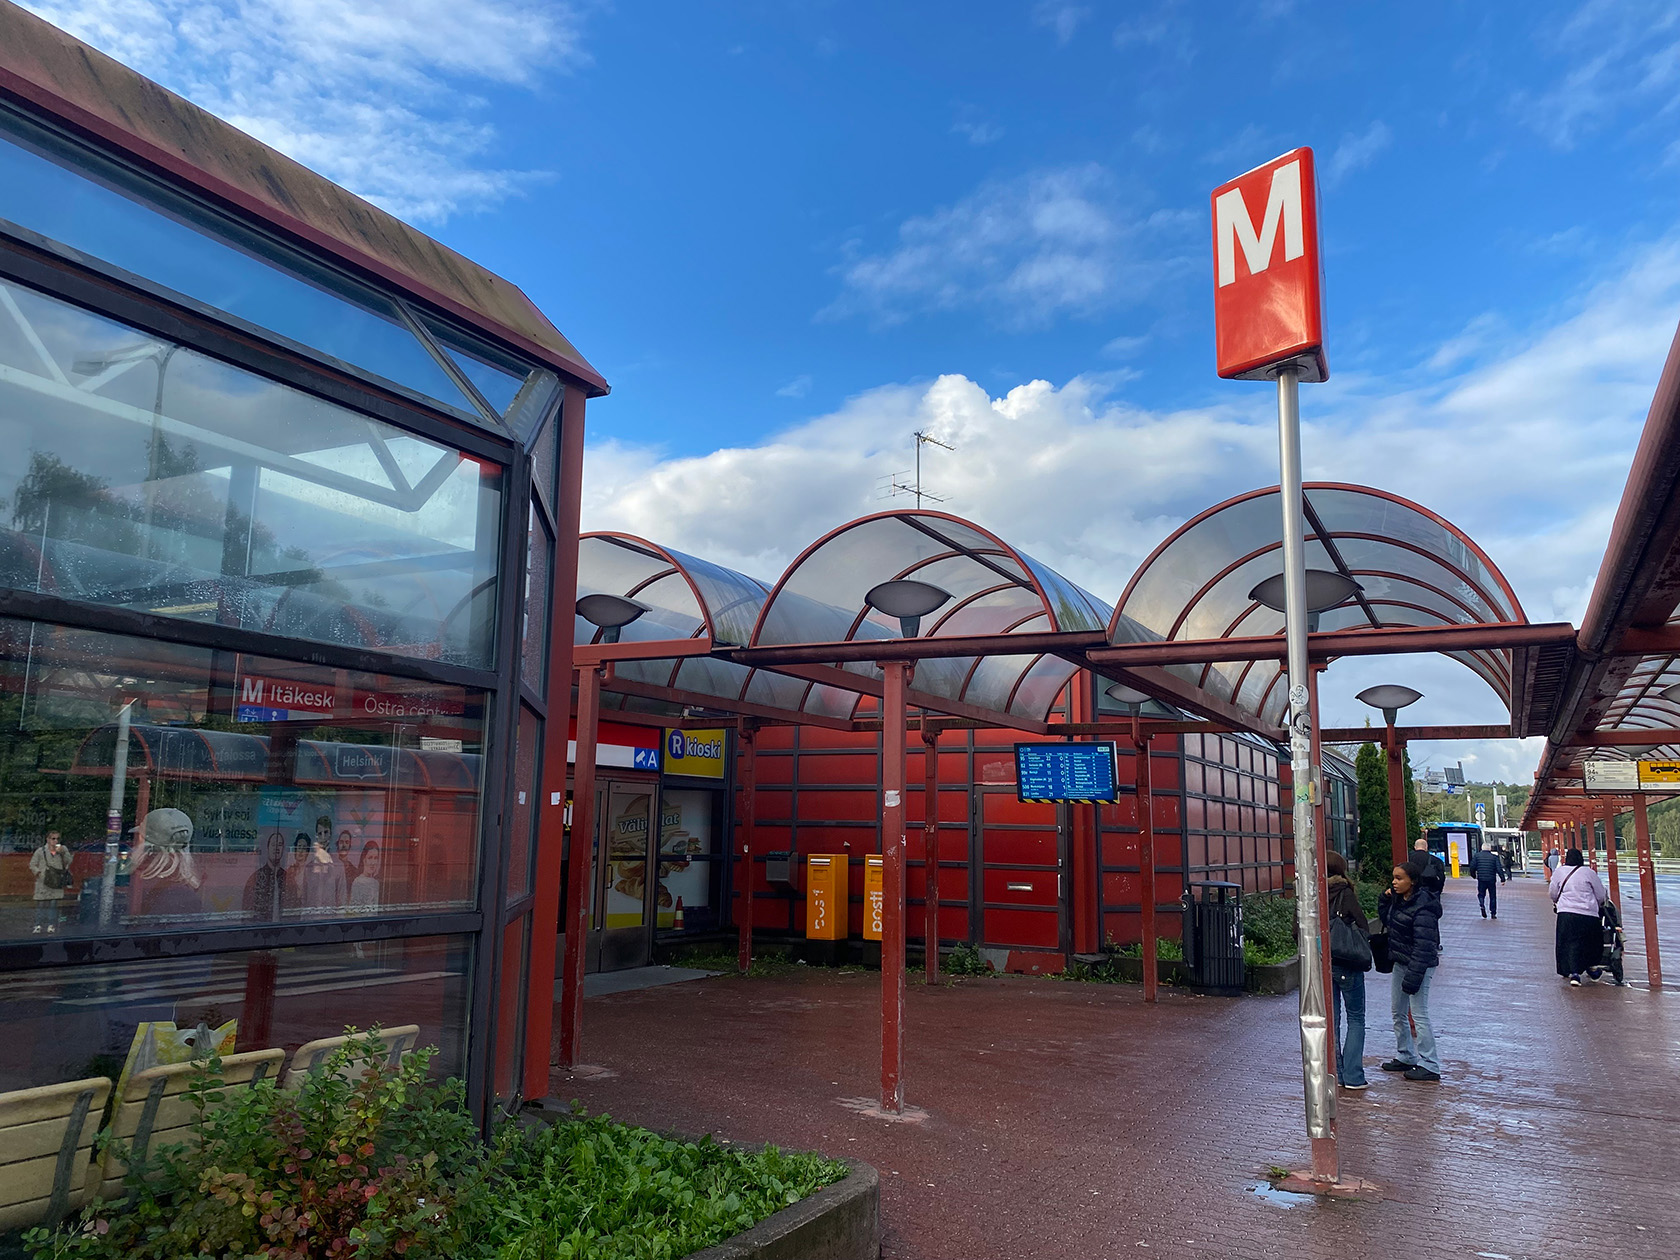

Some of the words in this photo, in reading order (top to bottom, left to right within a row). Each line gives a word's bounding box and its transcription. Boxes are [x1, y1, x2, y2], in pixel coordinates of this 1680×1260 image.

[1216, 159, 1304, 288] M
[242, 678, 264, 703] M
[270, 686, 334, 708] Itäkesk
[364, 694, 405, 716] Östra
[672, 735, 682, 754] R
[686, 737, 722, 758] kioski
[343, 754, 384, 767] Helsinki
[647, 751, 658, 768] A
[203, 826, 258, 839] Vuoalossa
[618, 813, 679, 834] Välilat
[870, 891, 882, 932] posti
